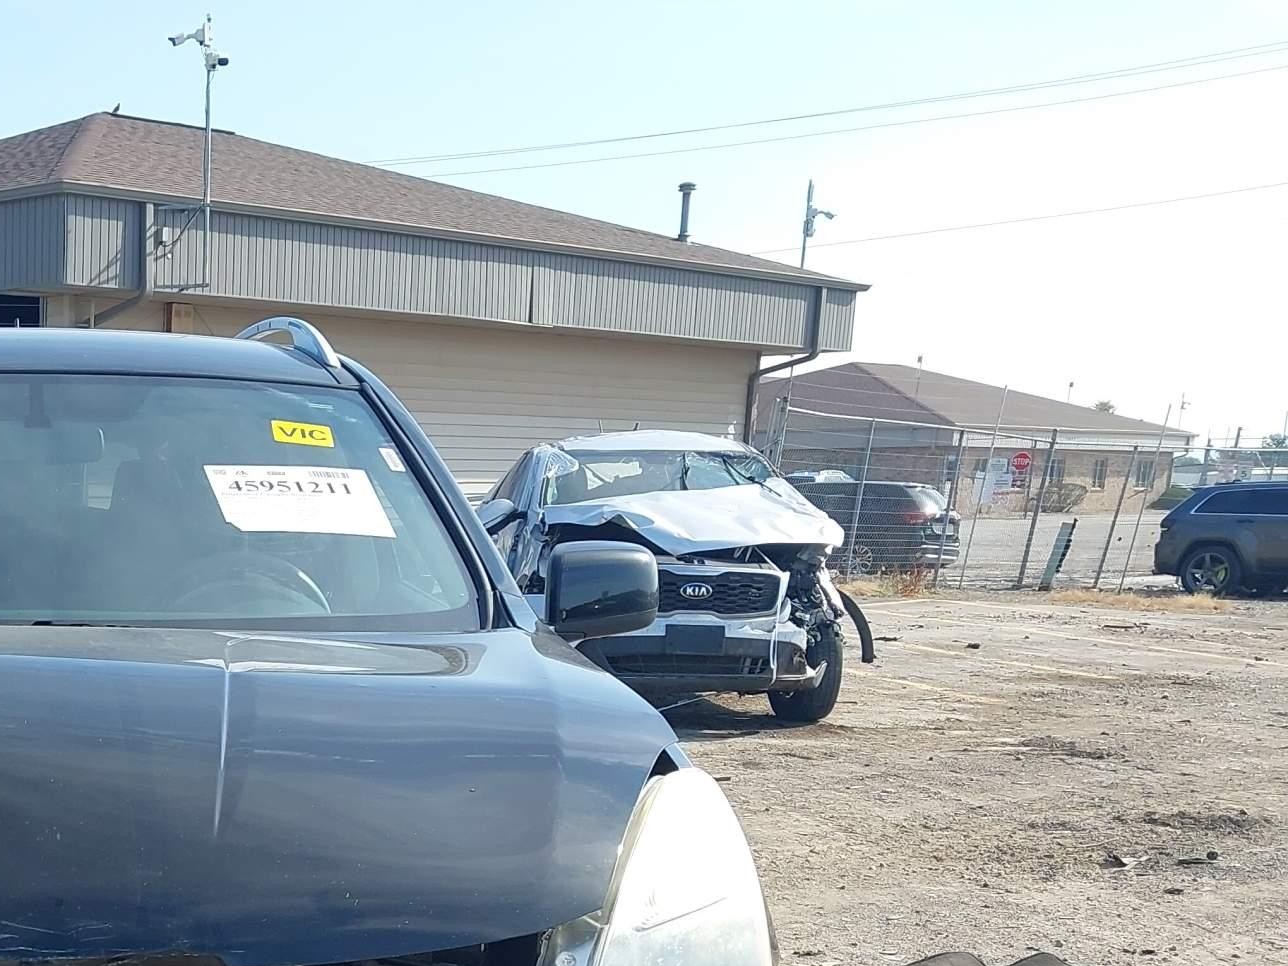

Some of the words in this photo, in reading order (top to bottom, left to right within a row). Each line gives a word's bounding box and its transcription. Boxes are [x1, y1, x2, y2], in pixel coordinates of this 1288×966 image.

[278, 427, 327, 441] VIC
[1013, 457, 1030, 466] STOP
[228, 480, 352, 495] 45951211
[685, 586, 708, 596] KIA
